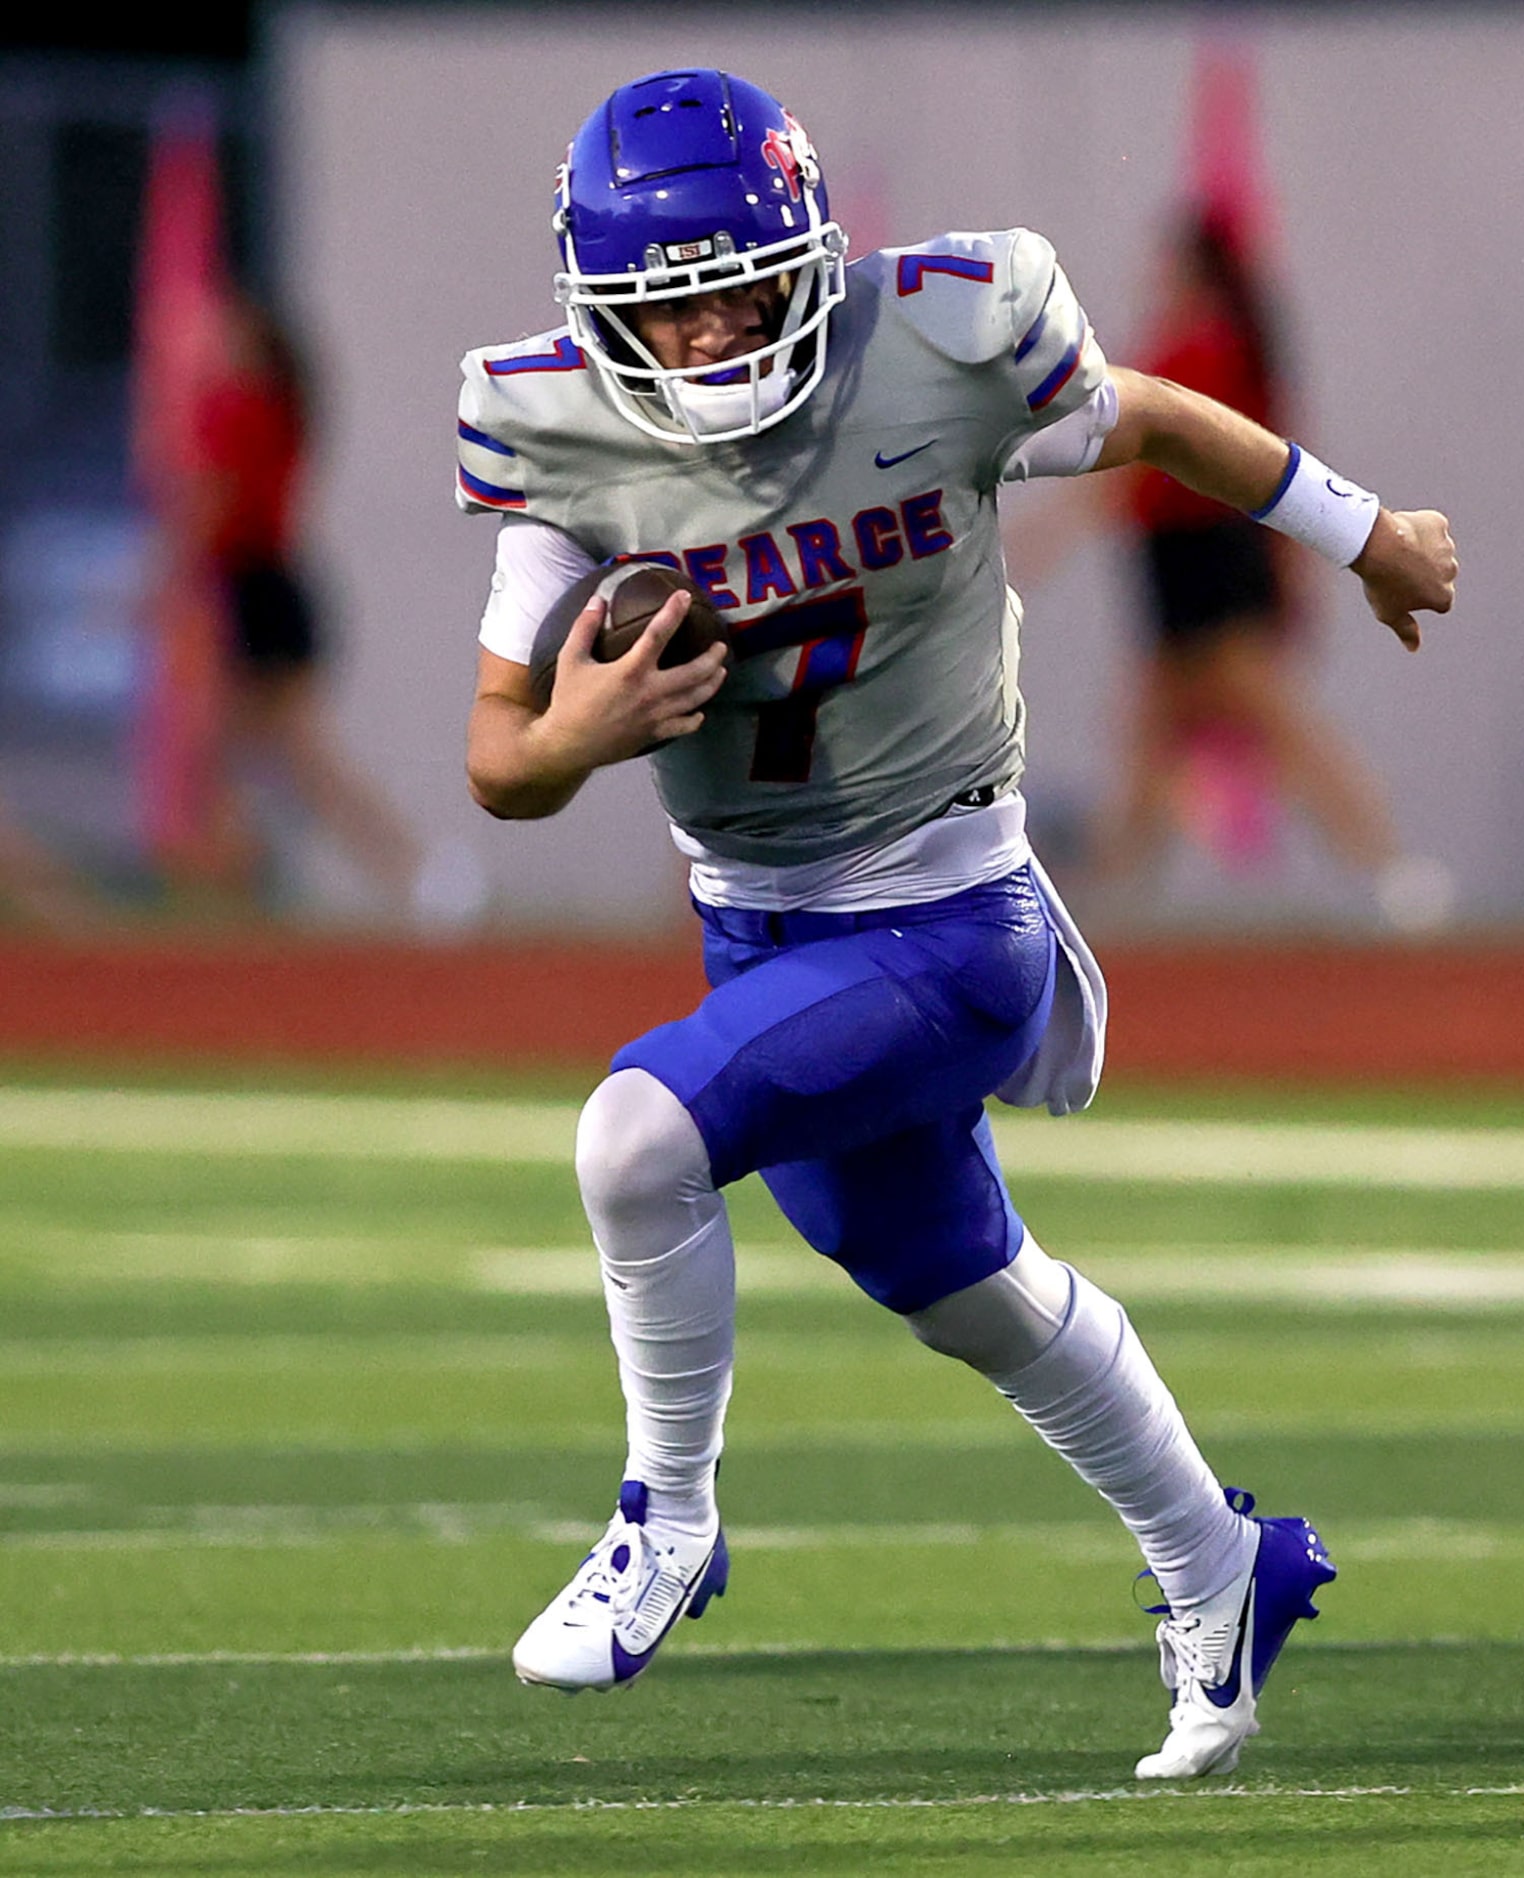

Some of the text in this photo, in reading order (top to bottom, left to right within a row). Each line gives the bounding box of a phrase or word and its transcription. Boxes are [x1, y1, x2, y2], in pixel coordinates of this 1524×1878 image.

[897, 253, 994, 296] 7
[483, 335, 586, 376] 7
[727, 586, 869, 783] 7
